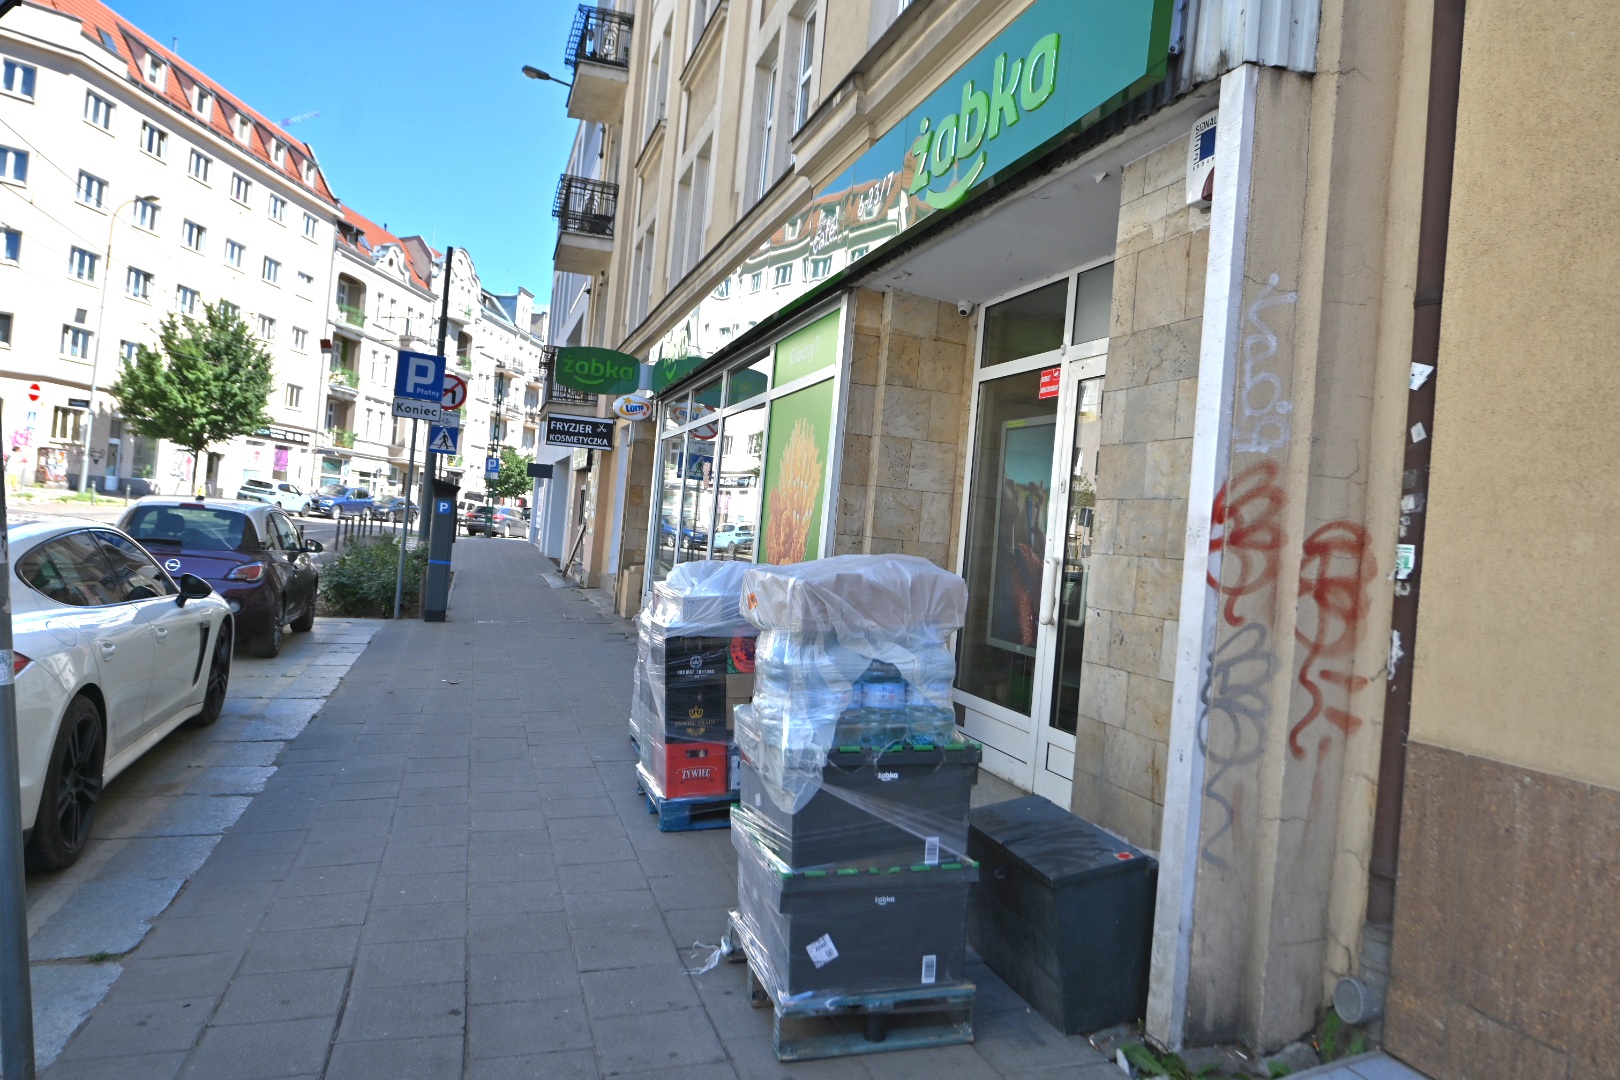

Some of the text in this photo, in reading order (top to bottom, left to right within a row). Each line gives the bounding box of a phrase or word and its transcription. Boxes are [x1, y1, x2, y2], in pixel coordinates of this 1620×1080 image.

[909, 32, 1060, 197] żabka
[406, 356, 435, 393] P
[562, 355, 633, 381] żabka
[416, 387, 440, 398] Płatny
[396, 402, 437, 417] Koniec
[625, 403, 645, 413] LOTTO
[550, 421, 592, 434] FRYZJER
[549, 433, 608, 446] KOSMETYCZKA
[440, 502, 448, 512] P
[877, 771, 899, 779] żabka
[875, 896, 895, 904] żabka
